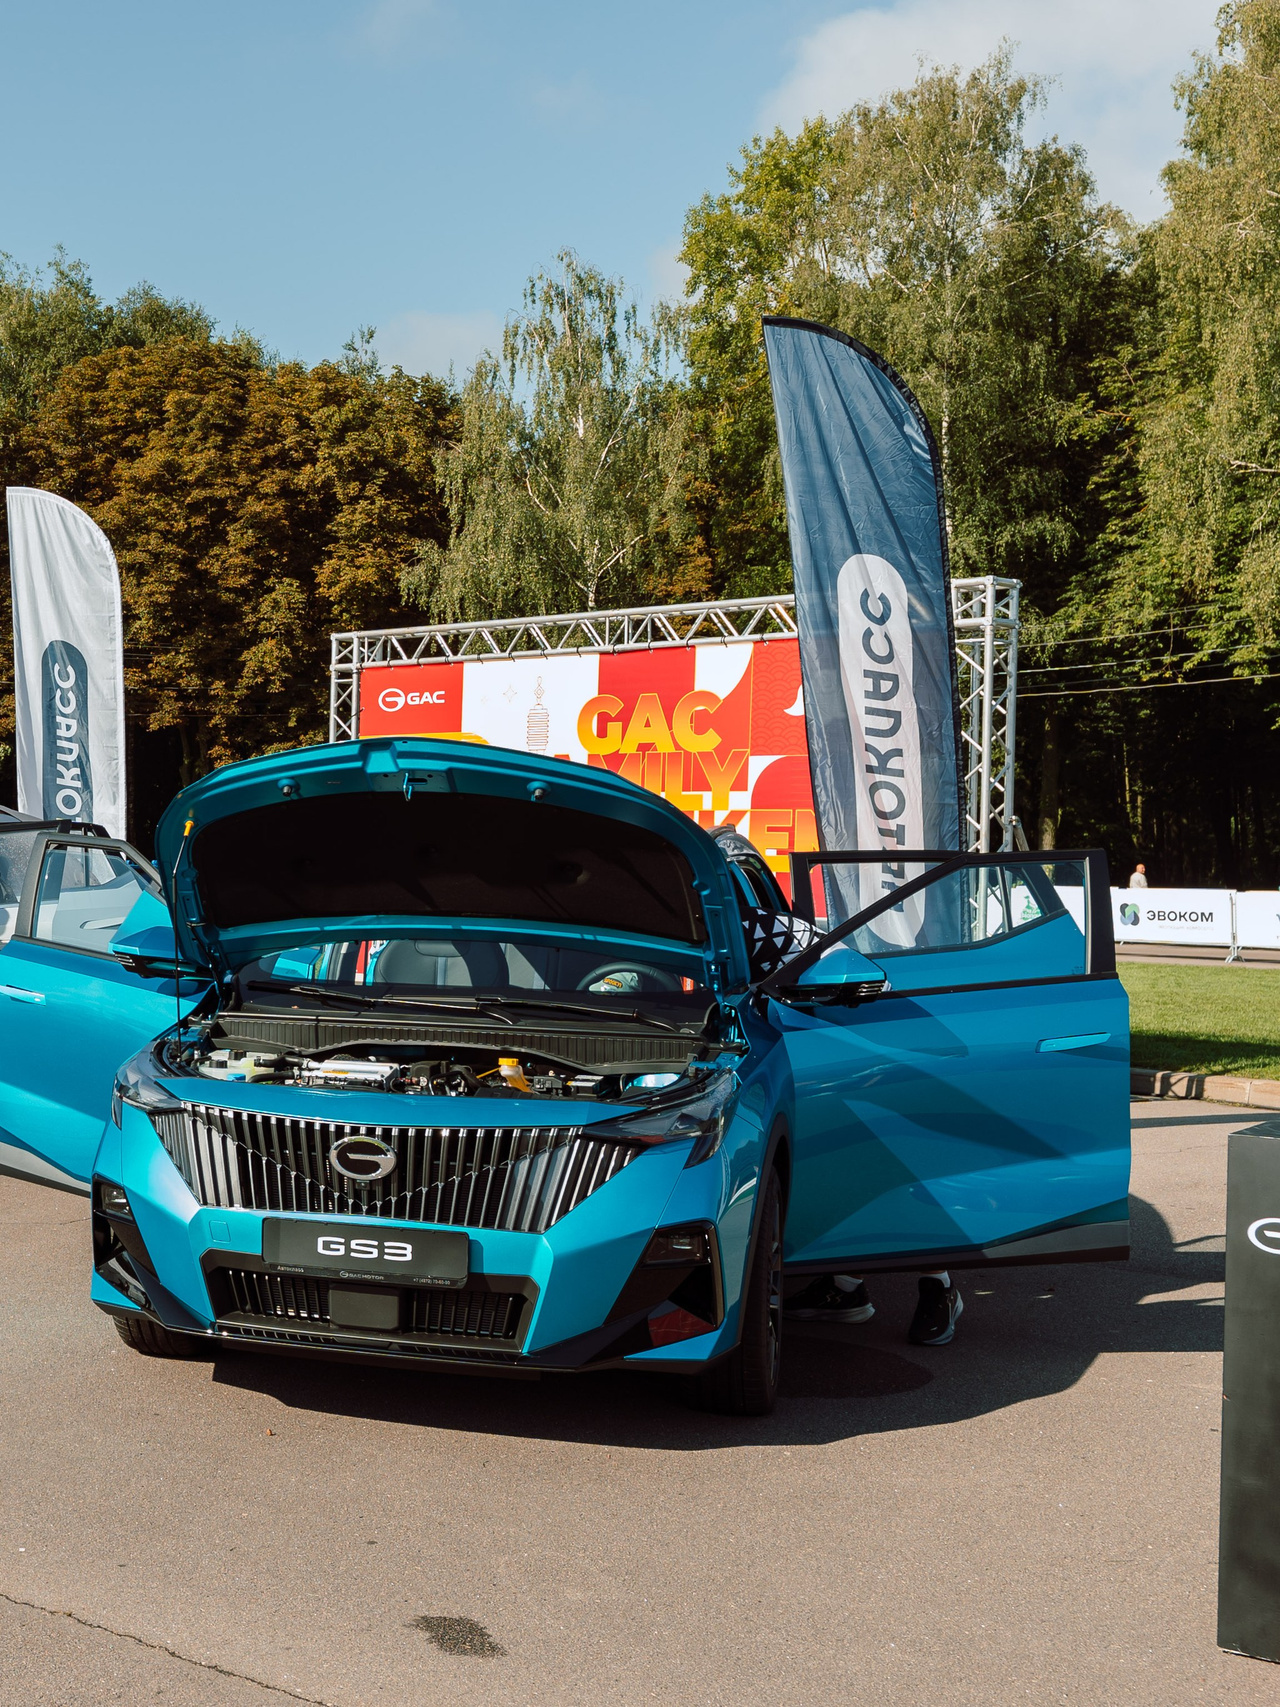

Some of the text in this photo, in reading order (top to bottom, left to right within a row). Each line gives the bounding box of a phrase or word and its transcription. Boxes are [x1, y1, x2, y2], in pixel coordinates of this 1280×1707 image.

[406, 690, 446, 705] GAC
[577, 690, 724, 754] GAC
[1146, 910, 1214, 923] ЭВОКОМ
[317, 1236, 413, 1262] GS3
